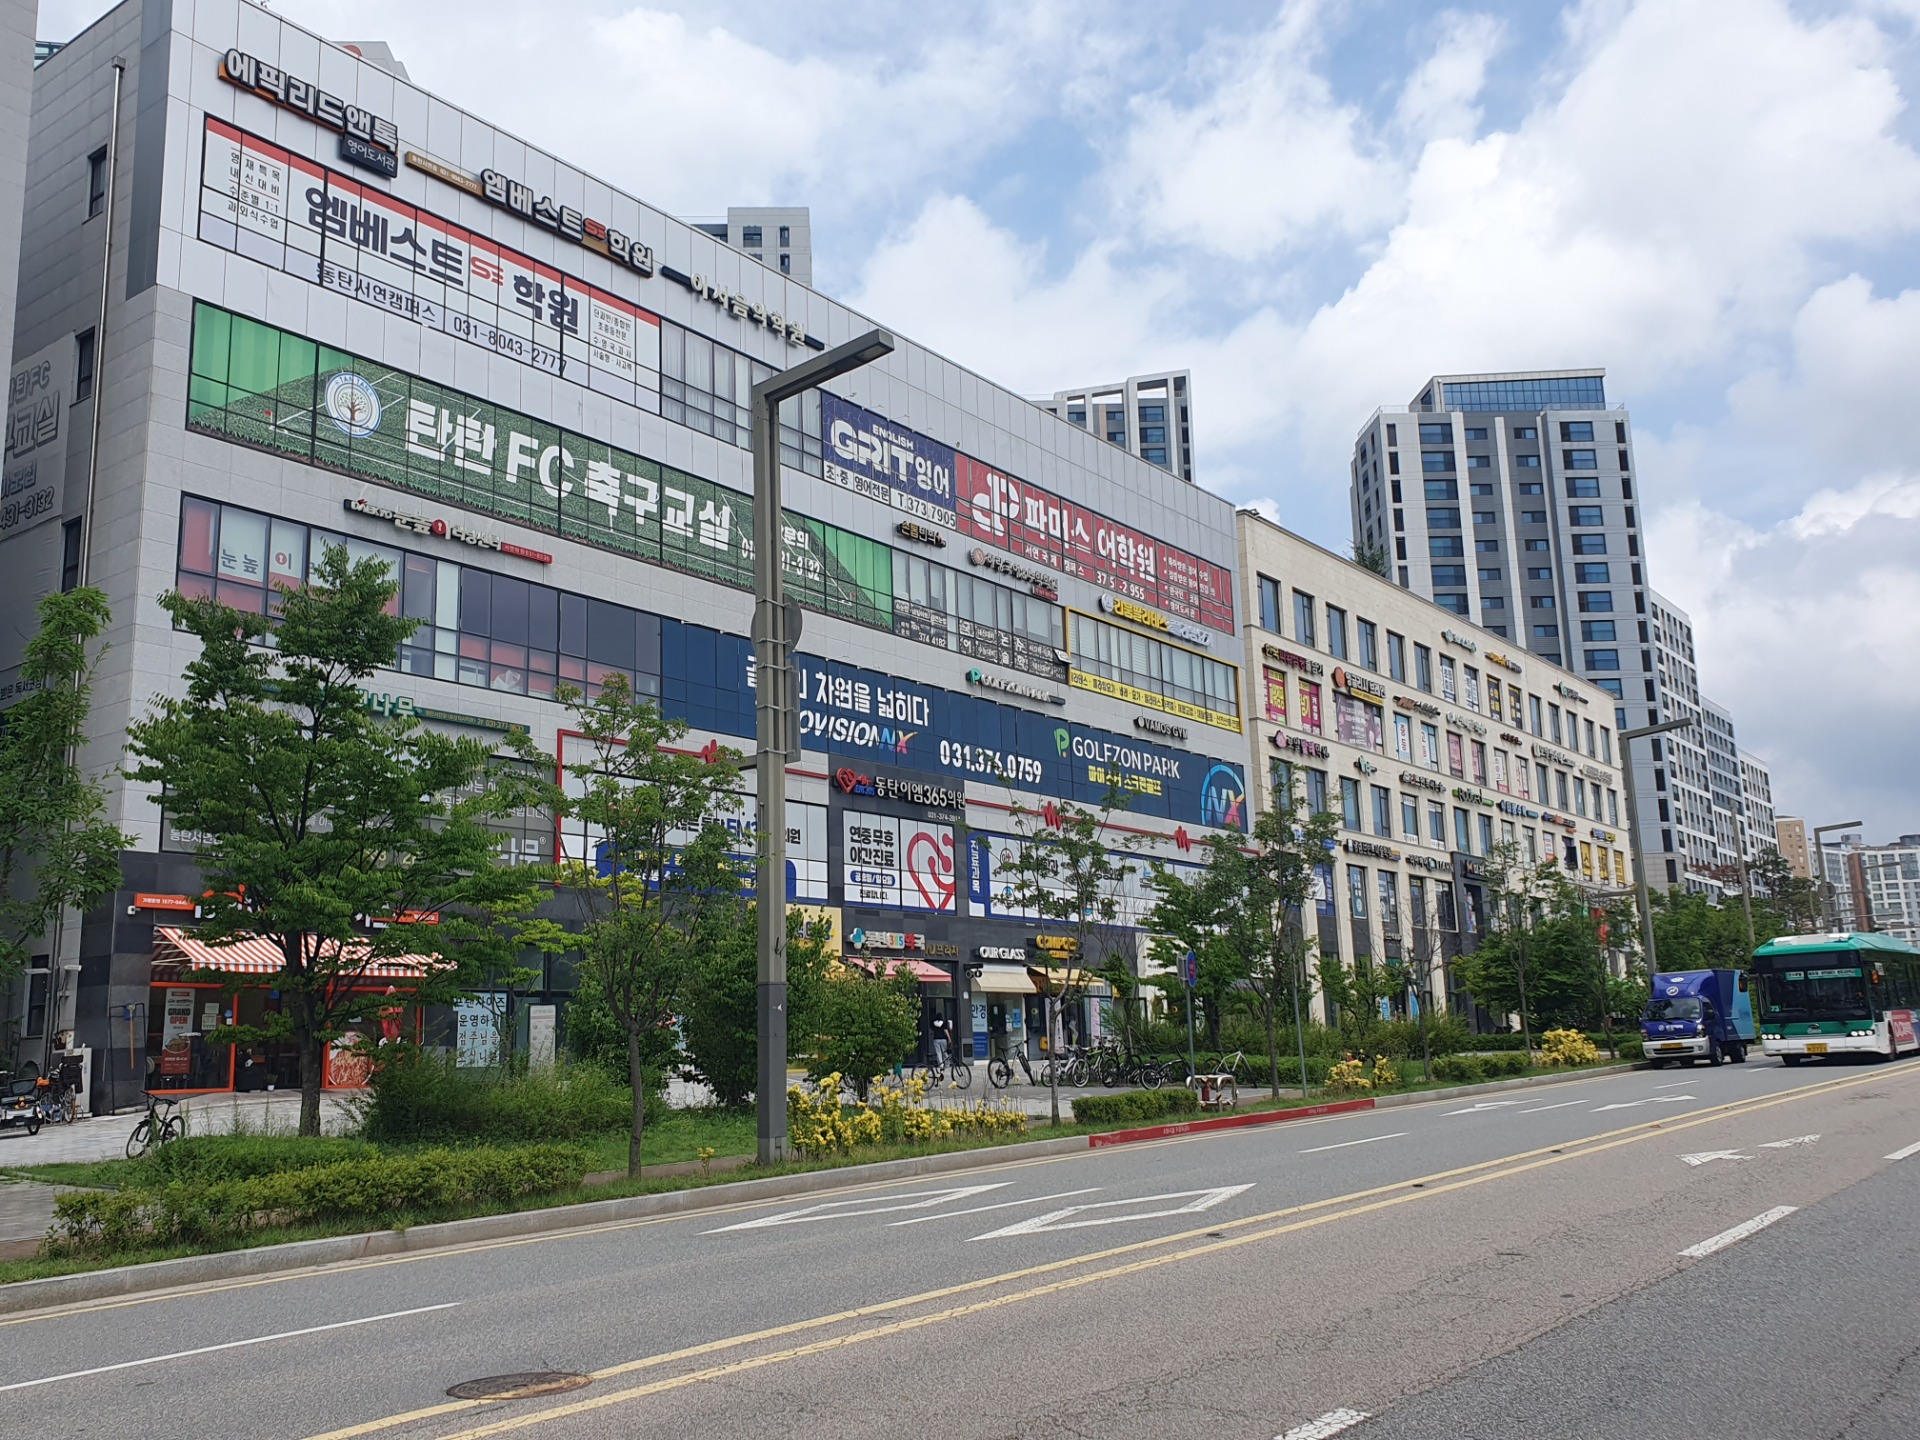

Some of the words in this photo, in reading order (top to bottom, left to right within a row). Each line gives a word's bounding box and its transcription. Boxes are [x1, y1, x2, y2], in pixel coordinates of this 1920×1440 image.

[225, 48, 398, 154] 에픽리드앤톡
[347, 139, 396, 172] 영어도서관
[229, 166, 281, 196] 내신대비
[227, 199, 280, 231] 과외식수업
[228, 184, 260, 206] 수준별
[264, 199, 280, 214] 1:1
[481, 168, 583, 242] 엠베스트
[607, 228, 654, 278] 학원
[304, 187, 465, 288] 엠베스트
[513, 273, 580, 336] 학원
[316, 262, 436, 324] 동탄서연캠퍼스
[452, 316, 568, 375] 031-8043-2777
[872, 423, 914, 450] ENGLISH
[405, 398, 497, 477] 탄탄
[506, 431, 575, 498] FC
[584, 459, 730, 552] 축구교실
[830, 418, 914, 483] GRIT
[914, 456, 950, 500] 영어
[854, 474, 890, 503] 영어전문
[393, 507, 450, 540] 눈높이
[1024, 497, 1092, 555] 파머스
[1097, 527, 1156, 583] 어학원
[220, 548, 293, 575] 눈높이
[918, 631, 931, 643] 374
[815, 670, 871, 714] 차원을
[876, 686, 930, 727] 넓히다
[1145, 717, 1172, 734] VAMOS
[1172, 720, 1189, 739] GYM
[939, 739, 1043, 785] 031.376.0759
[1072, 735, 1141, 769] GOLFZON
[1143, 754, 1181, 780] PARK
[849, 824, 895, 848] 연중무휴
[849, 845, 895, 868] 야간진료
[999, 947, 1026, 961] GLASS
[168, 1007, 191, 1016] GRAND
